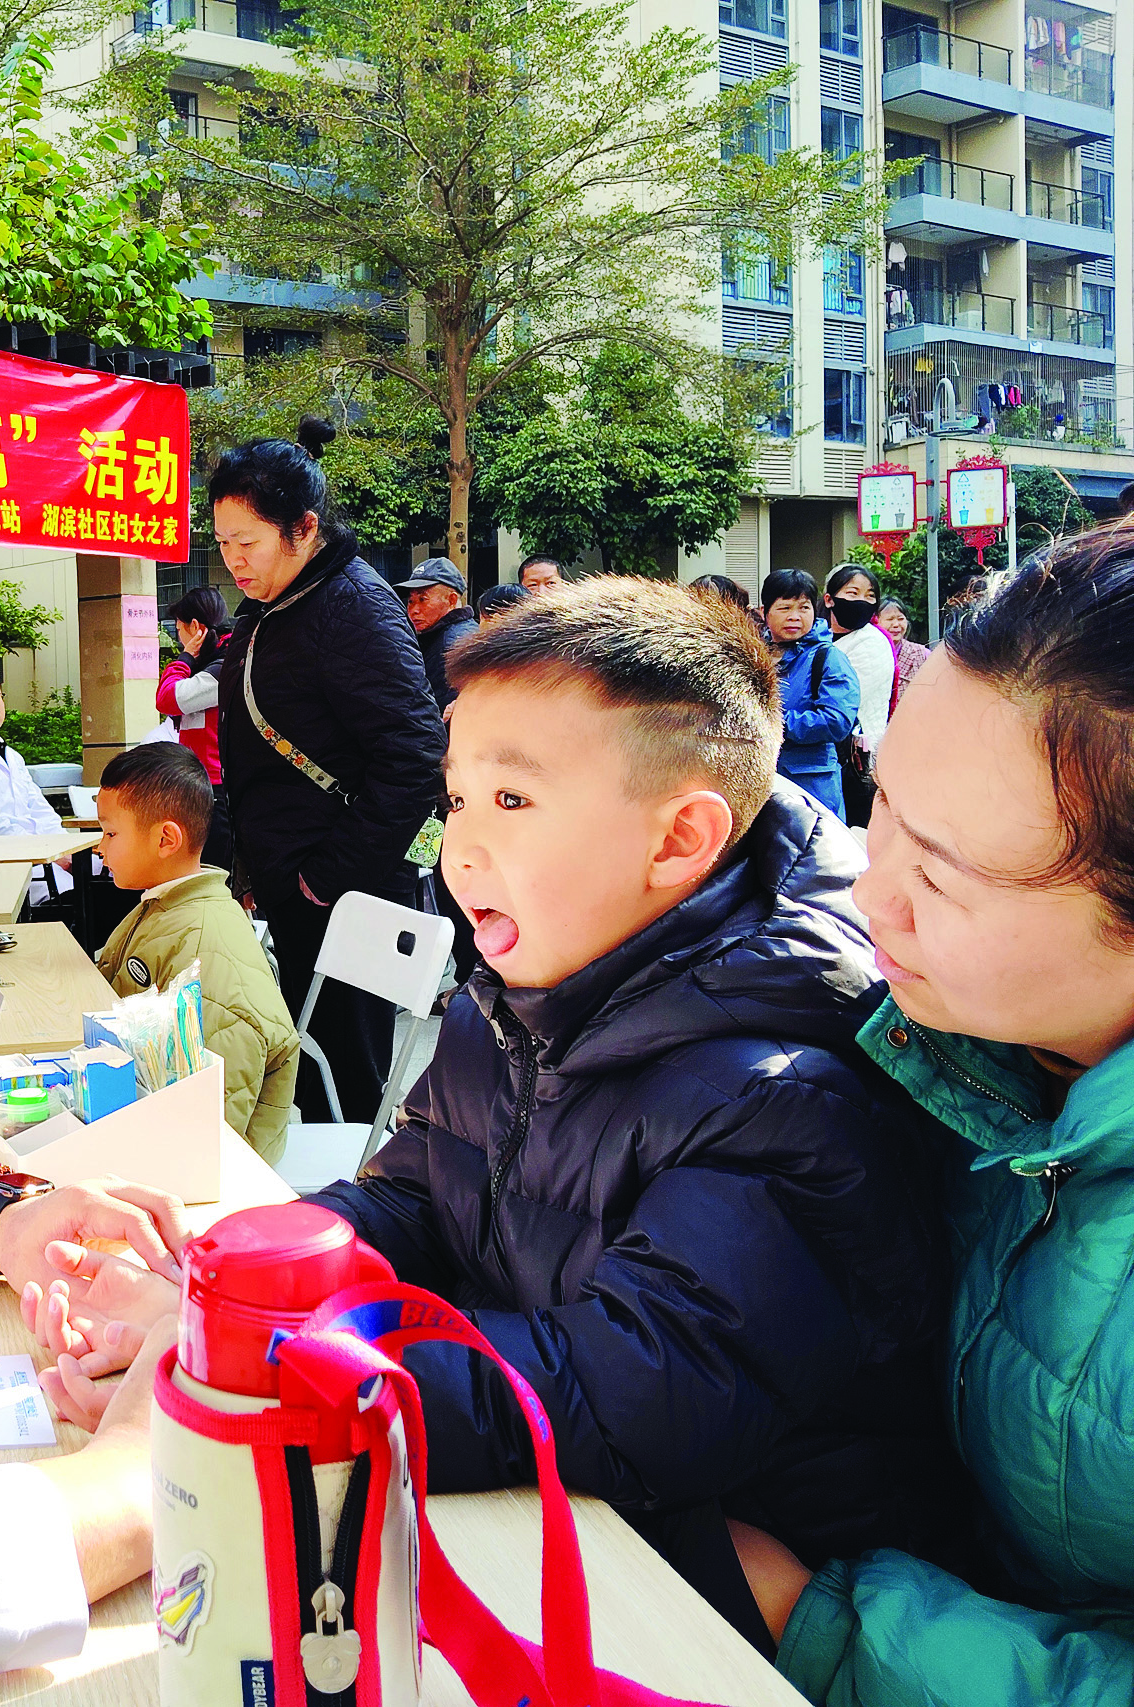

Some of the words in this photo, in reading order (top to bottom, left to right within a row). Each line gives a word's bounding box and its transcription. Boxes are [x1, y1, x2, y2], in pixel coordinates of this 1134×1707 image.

[78, 427, 178, 505] 活动
[42, 503, 178, 547] 湖滨社区妇女之家
[164, 1476, 198, 1510] ZERO
